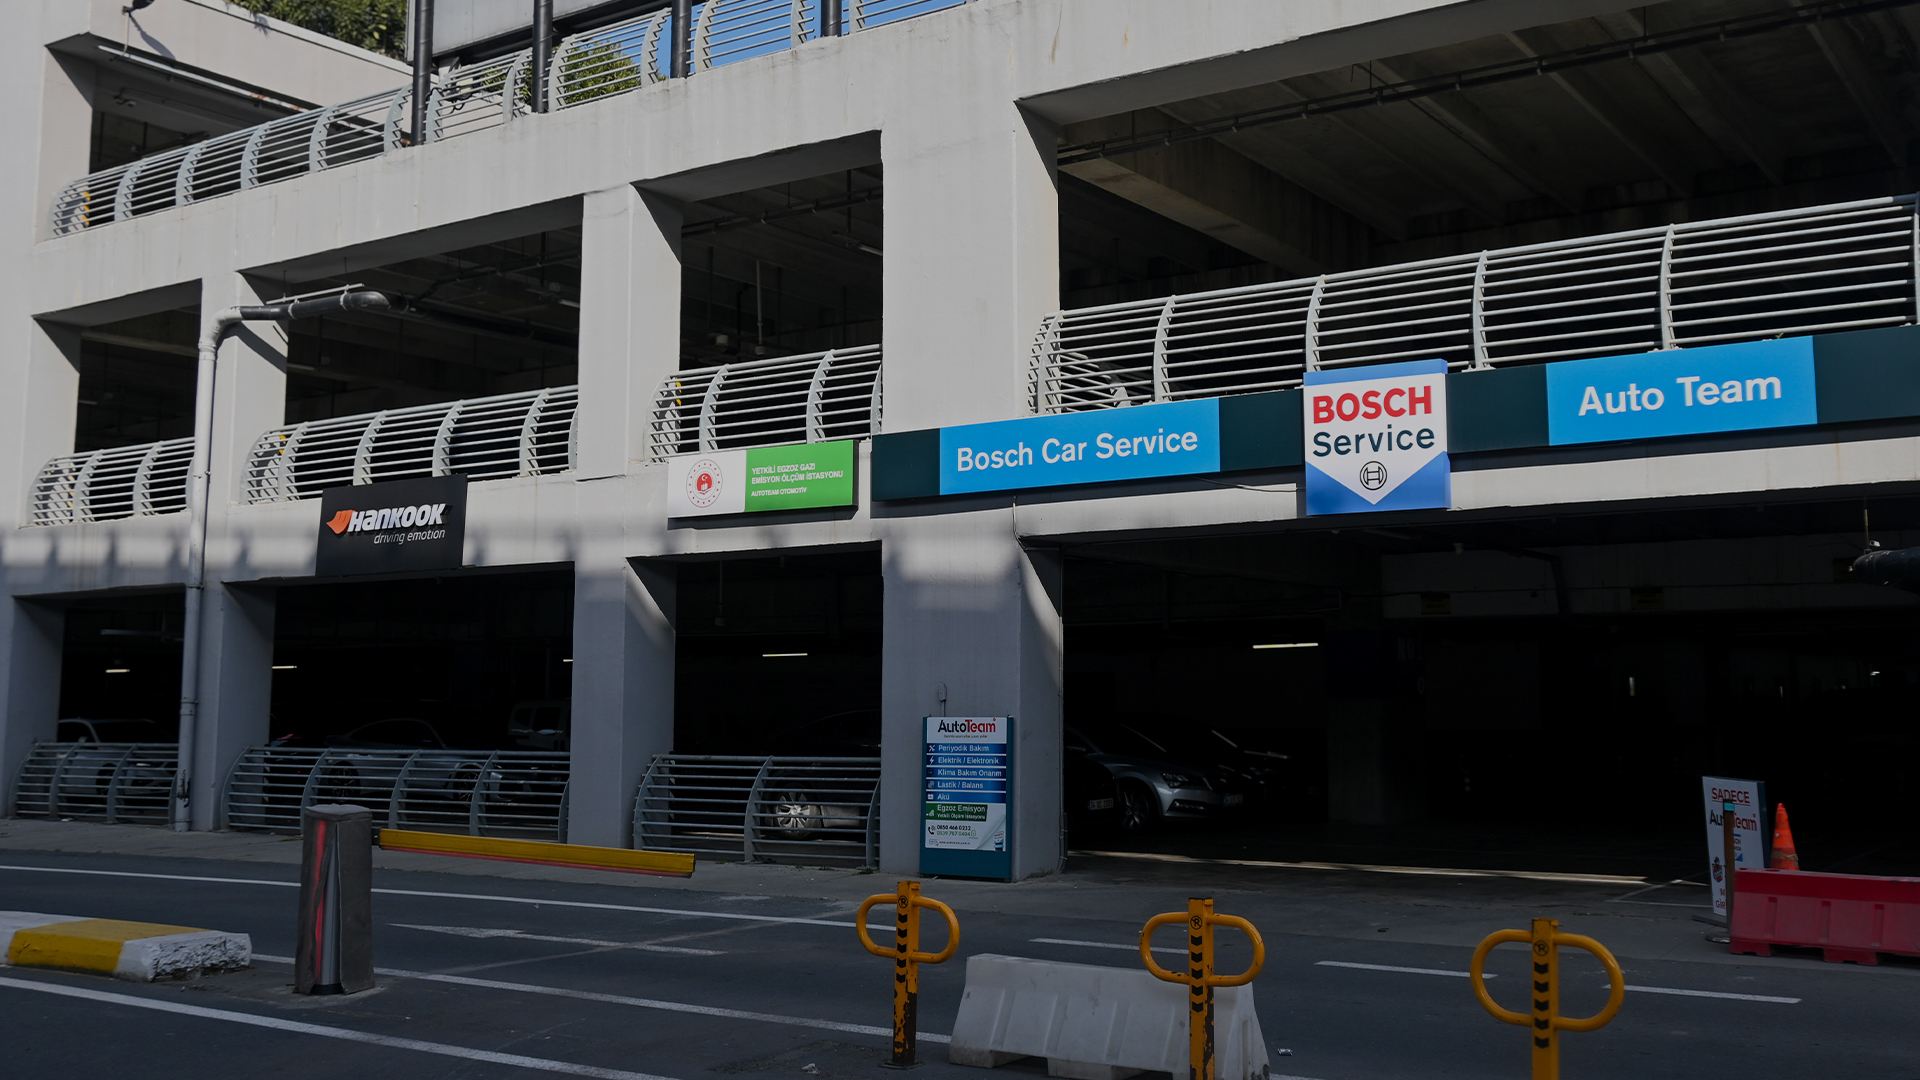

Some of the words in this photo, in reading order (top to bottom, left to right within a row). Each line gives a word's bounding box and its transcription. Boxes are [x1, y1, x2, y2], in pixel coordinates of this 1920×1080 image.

[1578, 383, 1665, 416] Auto
[1676, 376, 1782, 407] Team
[1313, 385, 1432, 424] BOSCH
[1313, 424, 1435, 457] Service
[957, 442, 1033, 472] Bosch
[1041, 438, 1088, 464] Car
[1095, 428, 1198, 459] Service
[777, 464, 799, 473] EGZOZ
[781, 472, 805, 483] ÖLÇÜM
[373, 531, 405, 545] driving
[407, 529, 446, 541] emotion
[937, 719, 996, 733] AutoTeam
[938, 745, 968, 753] Periyodik
[938, 756, 962, 764] Elektrik
[1712, 788, 1750, 803] SADECE
[937, 804, 957, 812] Egzoz
[957, 805, 986, 813] Emisyon
